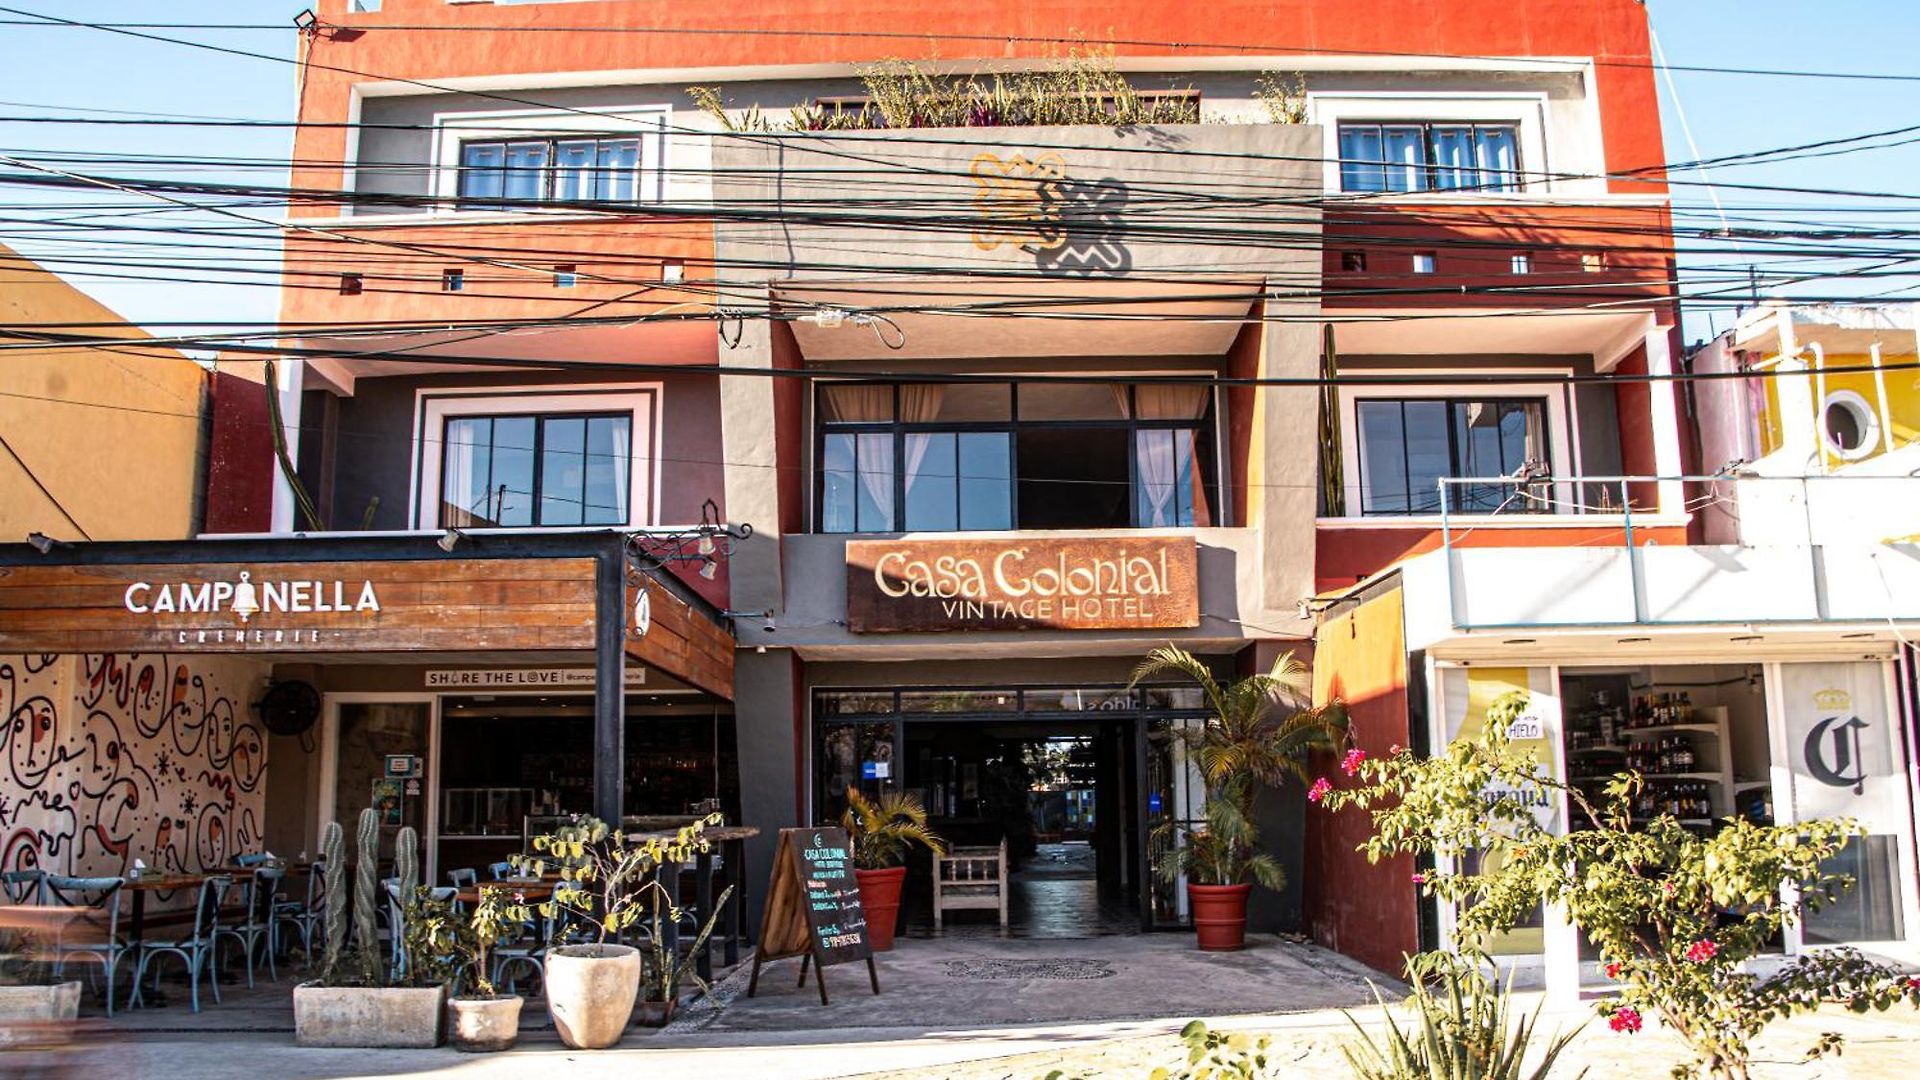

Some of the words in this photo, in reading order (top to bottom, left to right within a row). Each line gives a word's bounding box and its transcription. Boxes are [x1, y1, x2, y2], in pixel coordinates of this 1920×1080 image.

[875, 550, 988, 598] Casa
[993, 547, 1171, 597] Colonial
[942, 600, 1051, 619] VINTAGE
[1061, 598, 1153, 618] HOTEL
[486, 672, 513, 684] THE
[1508, 724, 1538, 738] HIELO
